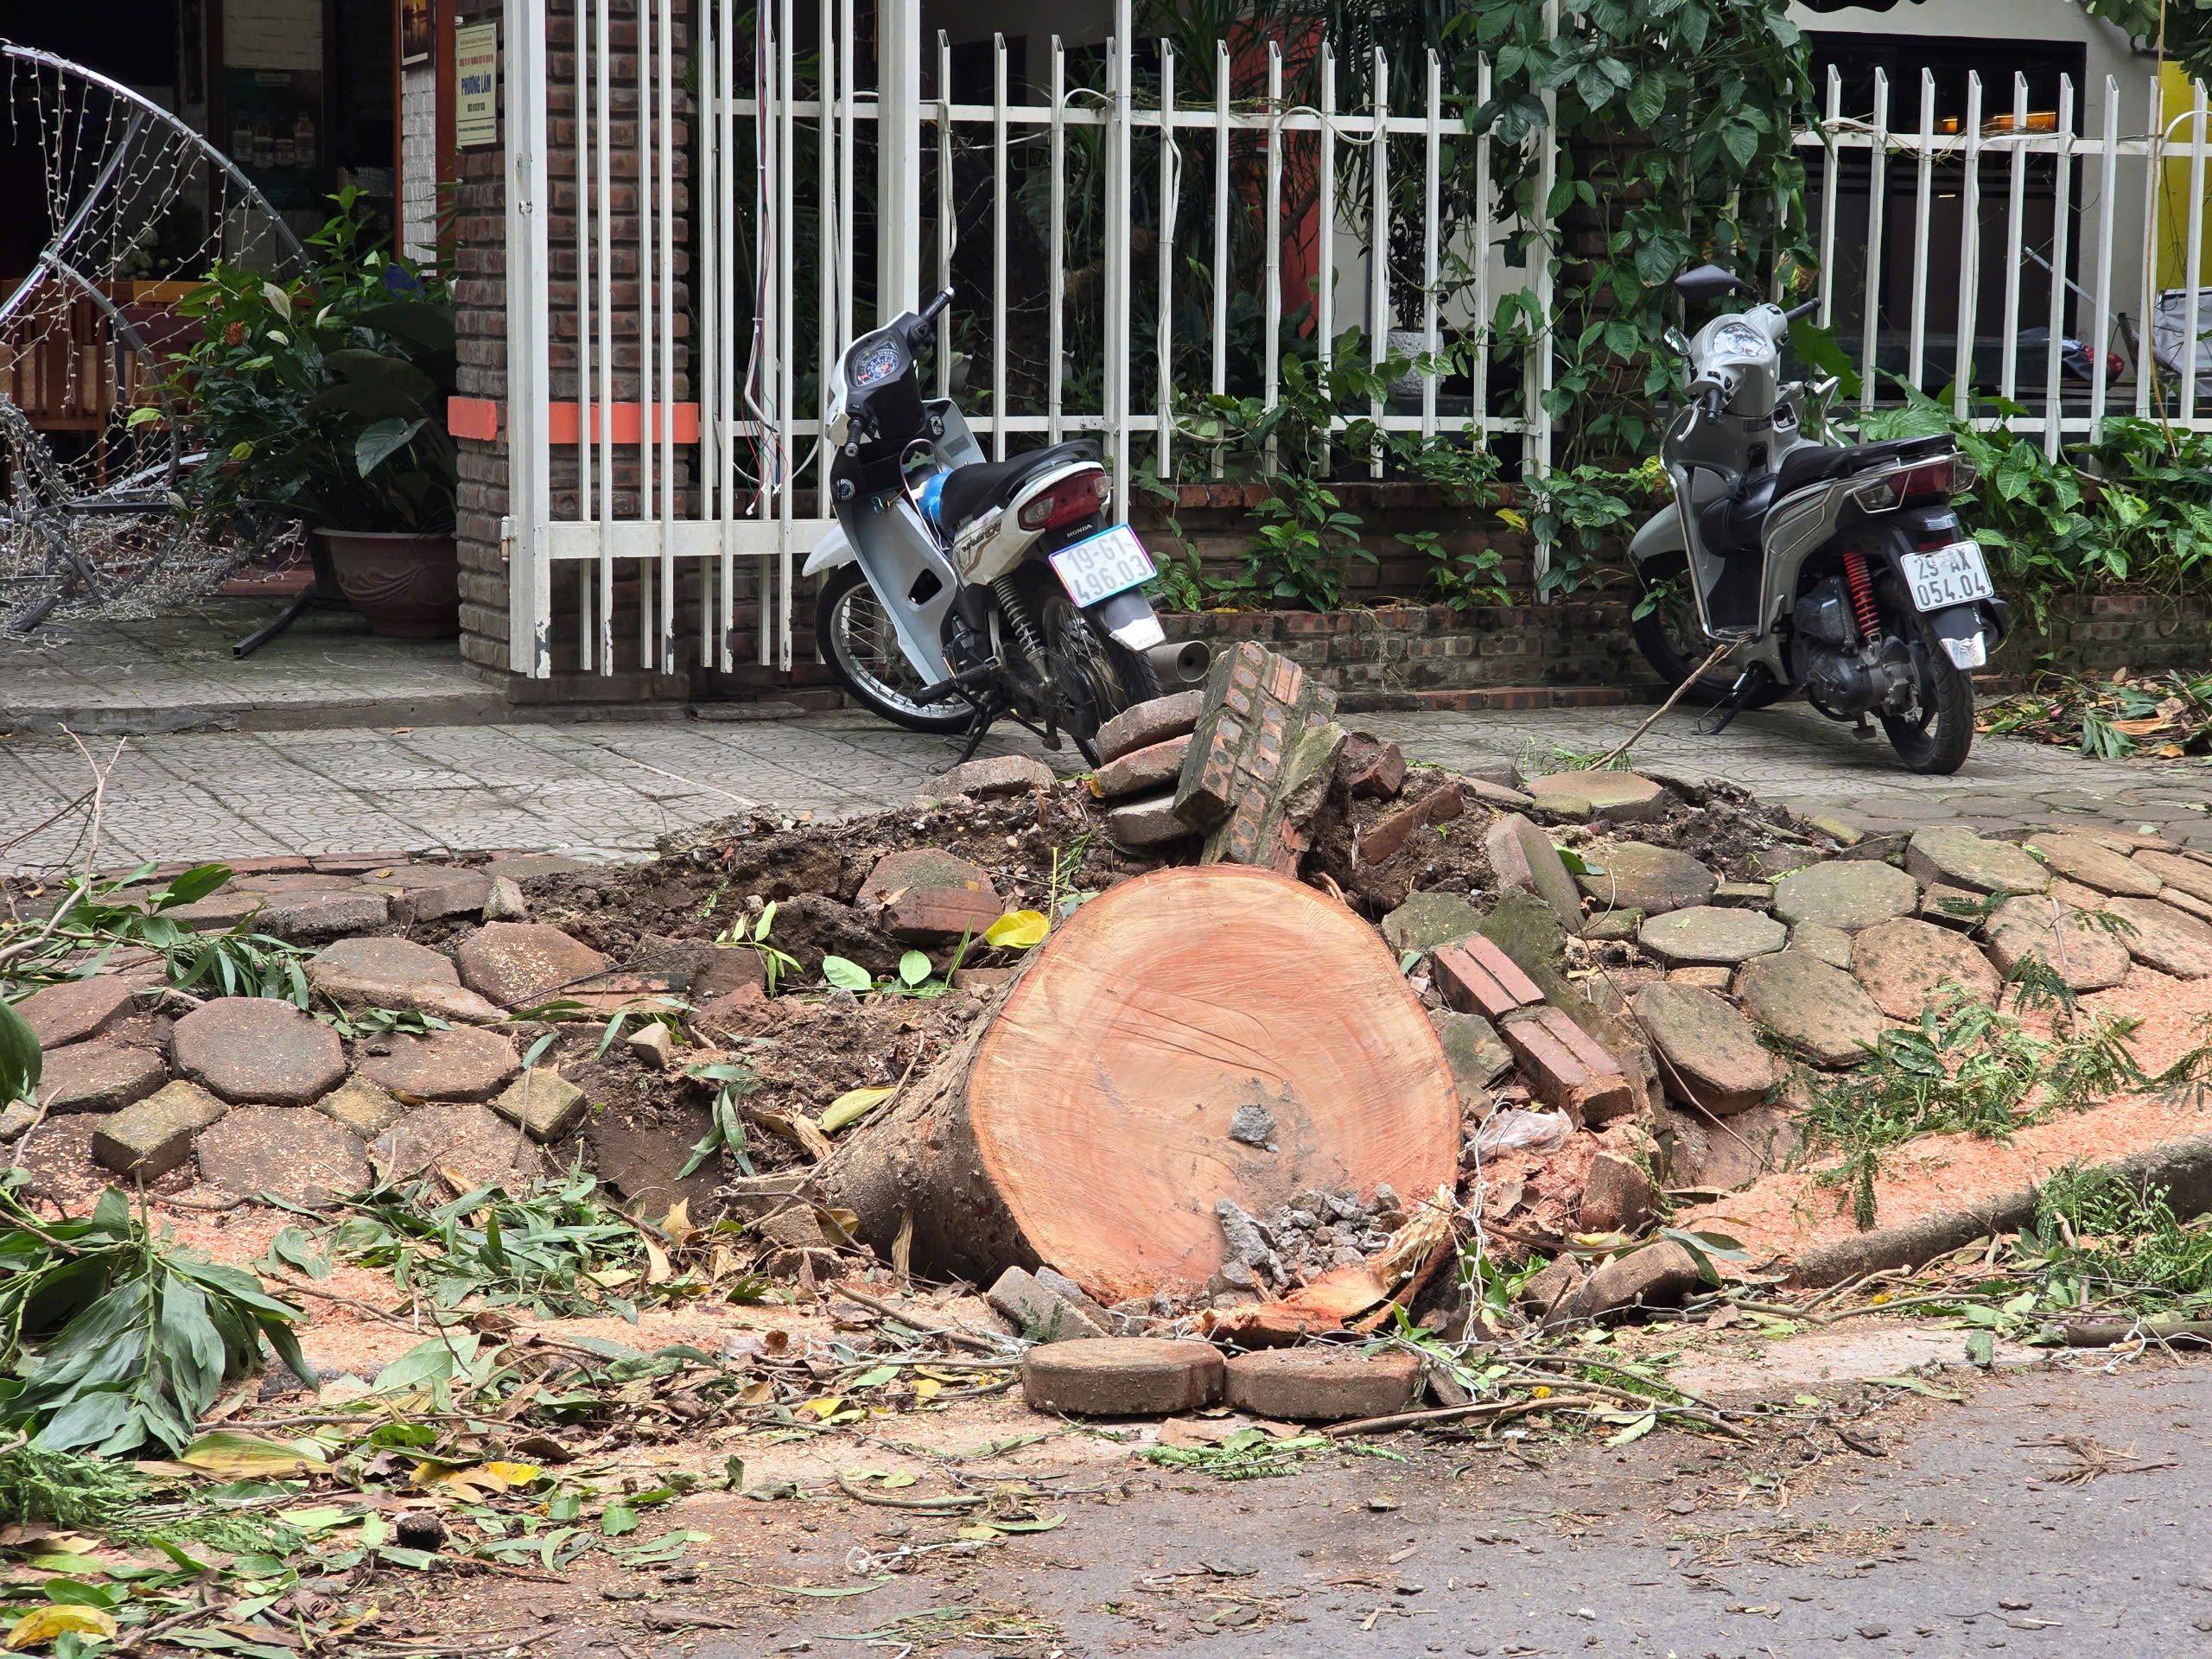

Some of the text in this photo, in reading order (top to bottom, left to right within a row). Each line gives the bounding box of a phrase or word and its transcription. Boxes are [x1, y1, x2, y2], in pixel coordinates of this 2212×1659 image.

[1066, 524, 1092, 537] HONDA
[1067, 533, 1126, 573] 19-G1
[1074, 555, 1147, 600] 496.03
[1917, 572, 1985, 606] 054.04
